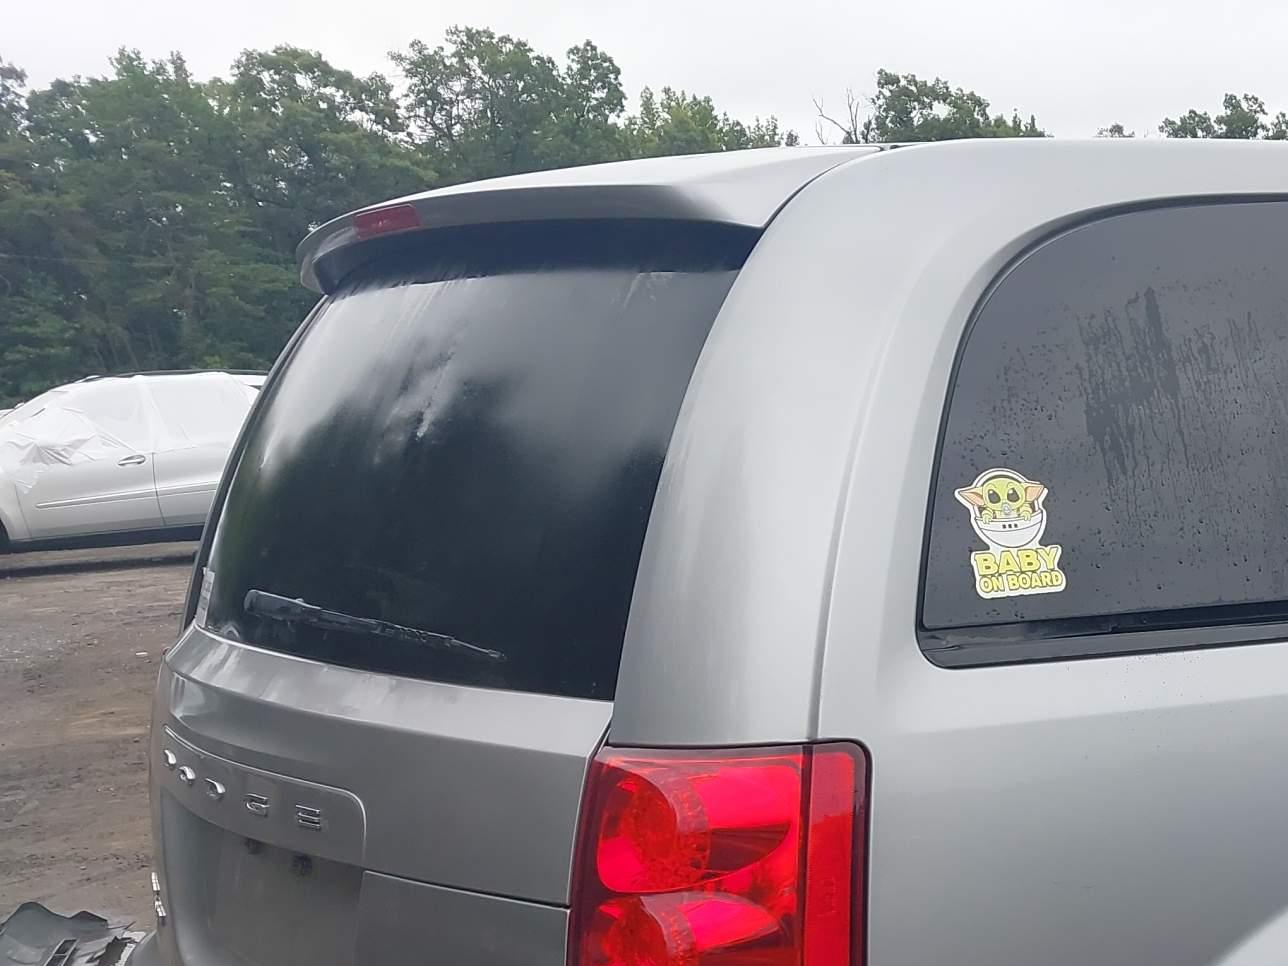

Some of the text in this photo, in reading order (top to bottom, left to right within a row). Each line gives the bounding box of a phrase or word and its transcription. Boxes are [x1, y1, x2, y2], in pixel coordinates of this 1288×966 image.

[973, 547, 1059, 576] BABY
[979, 571, 1063, 594] ON BOARD
